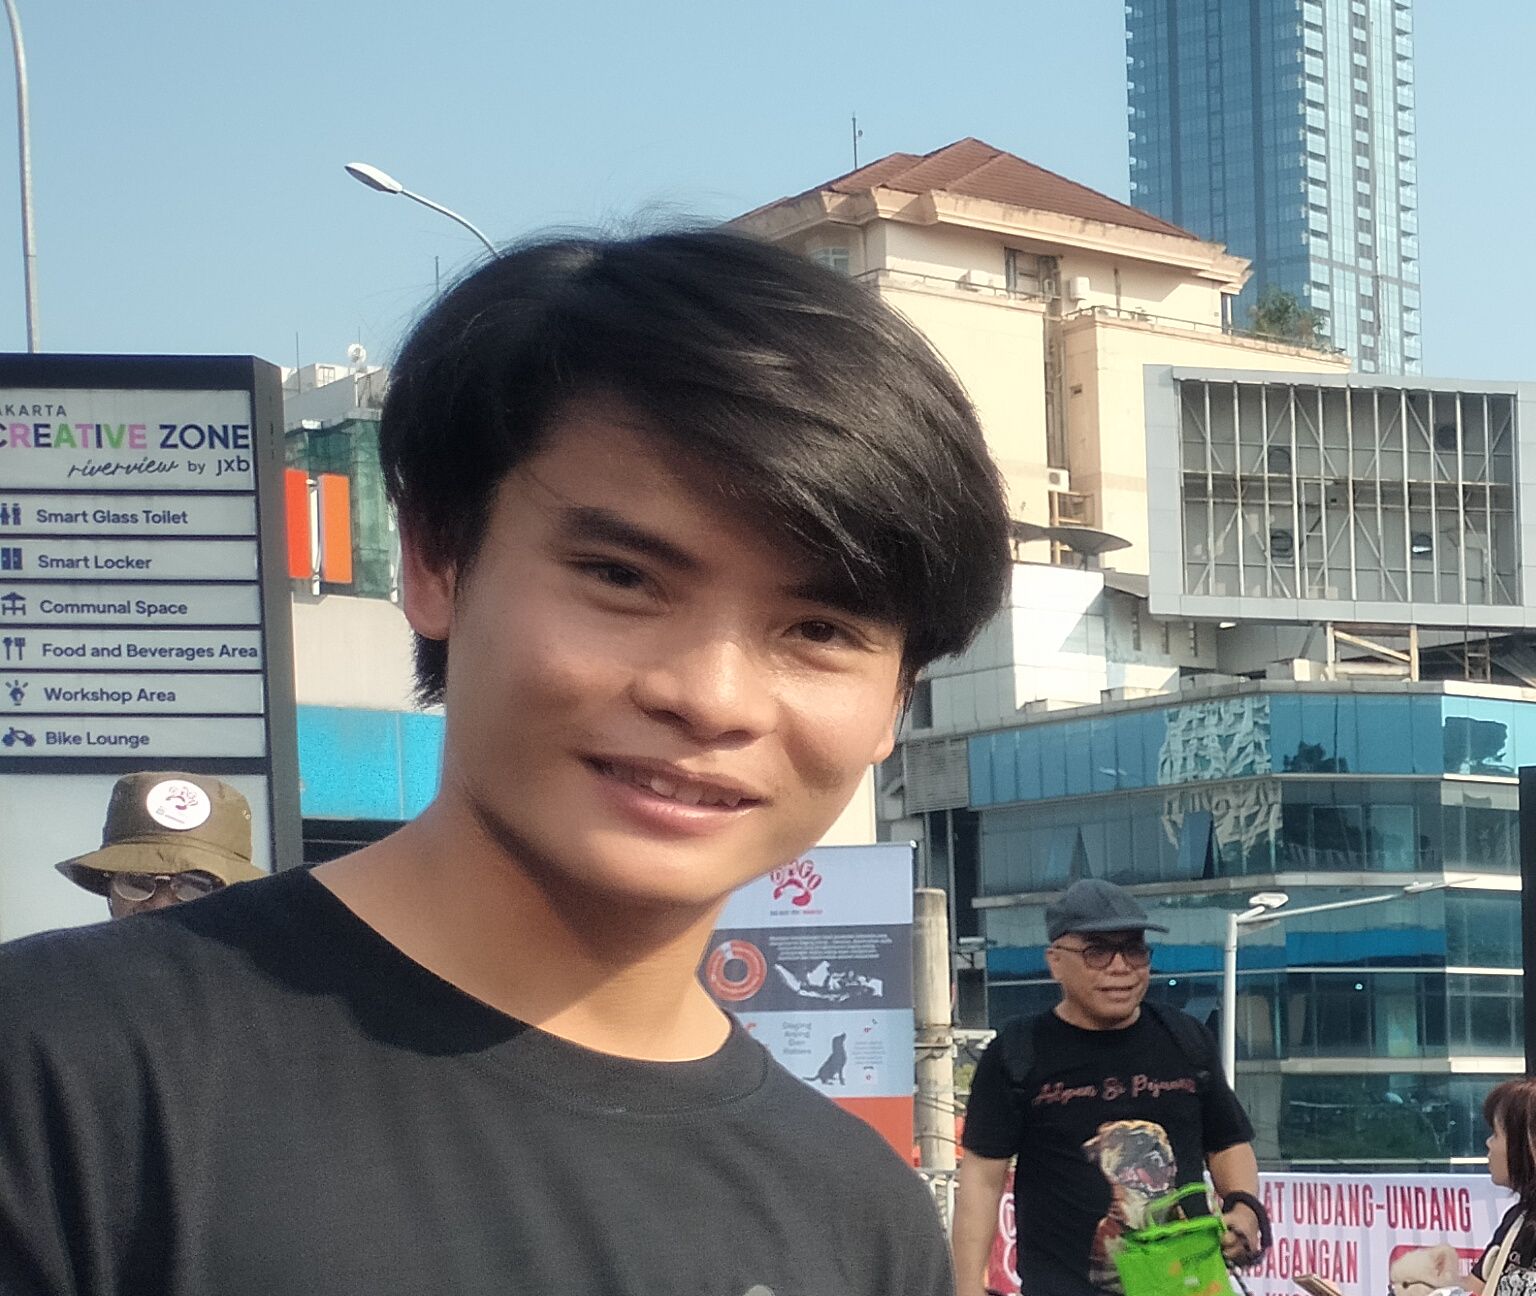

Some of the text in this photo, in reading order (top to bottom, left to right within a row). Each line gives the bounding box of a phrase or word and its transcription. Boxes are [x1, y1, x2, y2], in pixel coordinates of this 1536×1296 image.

[0, 404, 67, 417] KARTA
[159, 424, 250, 450] ZONE
[67, 456, 180, 480] riverview
[187, 460, 206, 476] by
[36, 508, 188, 526] Smart Glass Toilet
[38, 554, 152, 570] Smart Locker
[40, 600, 188, 620] Communal Space
[42, 644, 258, 662] Food and Beverages Area
[44, 688, 176, 706] Workshop Area
[45, 732, 150, 750] Bike Lounge
[1292, 1182, 1472, 1233] UNDANG-UNDANG
